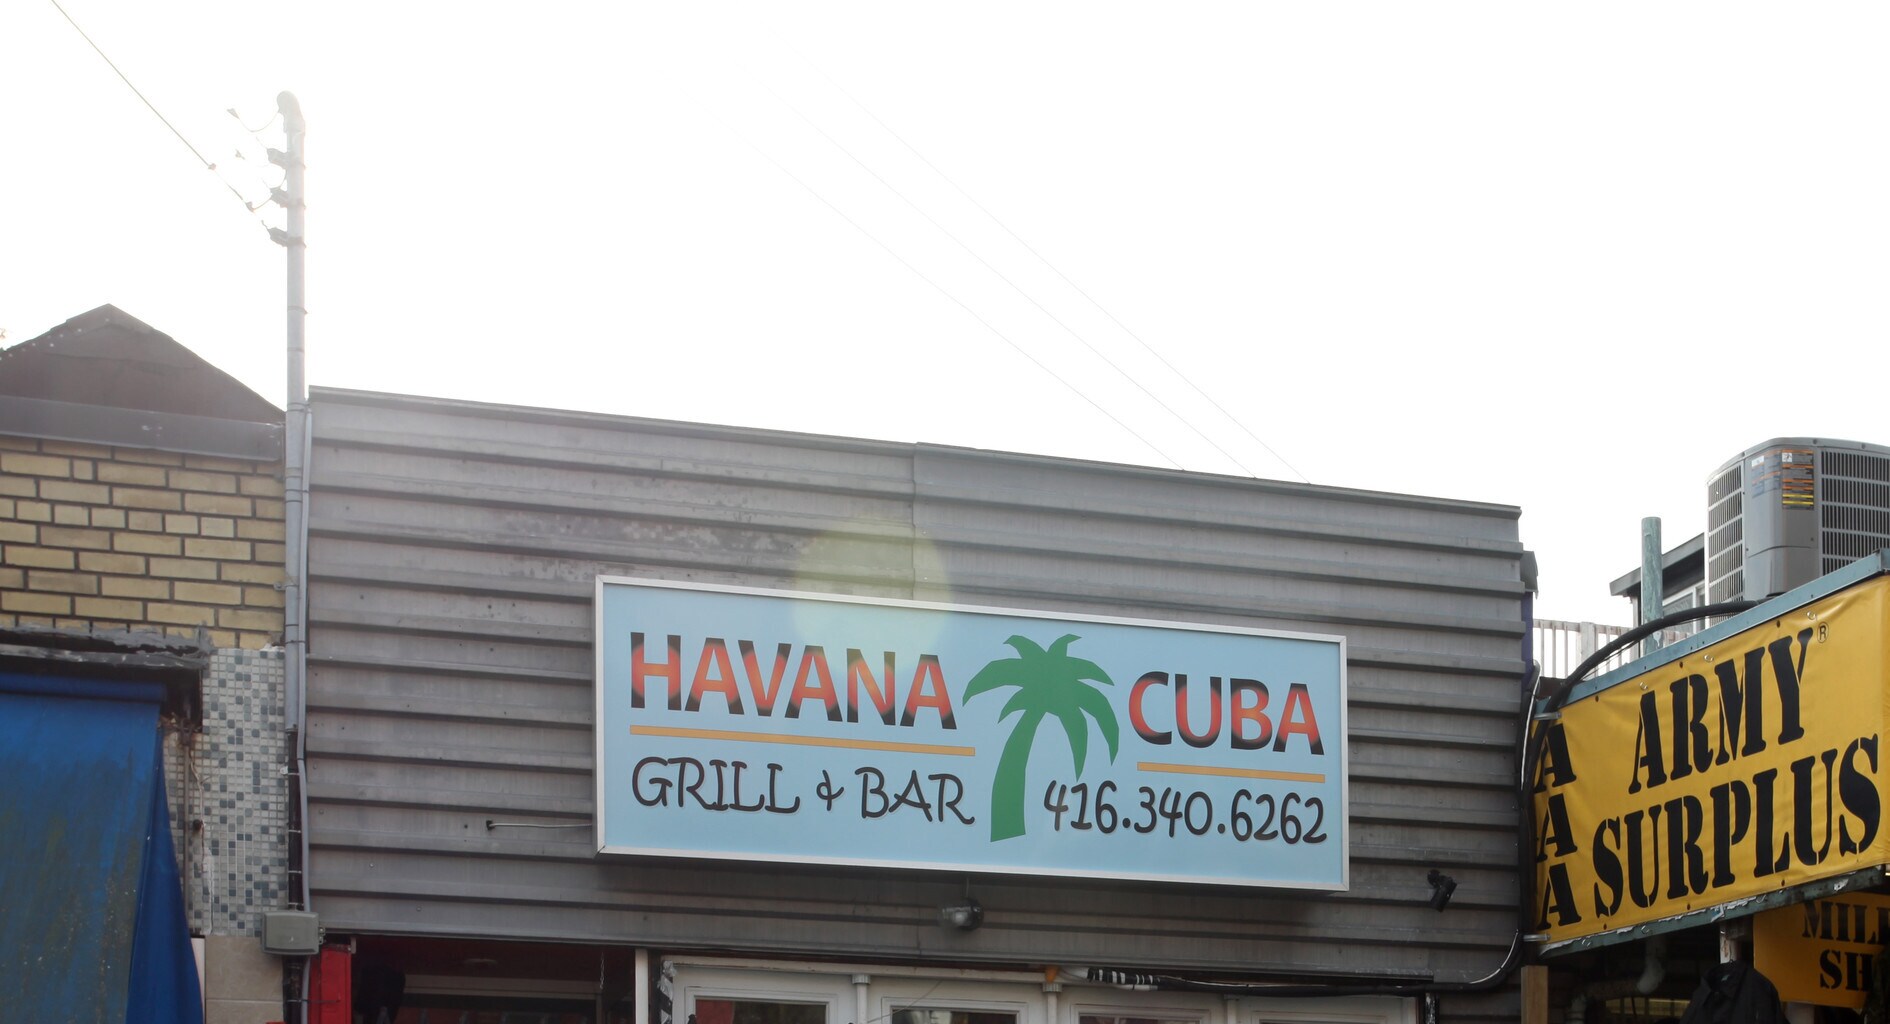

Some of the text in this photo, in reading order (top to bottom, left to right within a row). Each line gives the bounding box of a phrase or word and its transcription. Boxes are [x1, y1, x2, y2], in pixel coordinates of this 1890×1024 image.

[630, 631, 1325, 756] HAVANA CUBA
[1628, 627, 1814, 795] ARMY
[631, 756, 976, 825] GRILL & BAR
[1043, 779, 1328, 845] 416.340.6262
[1592, 733, 1881, 919] SURPLUS
